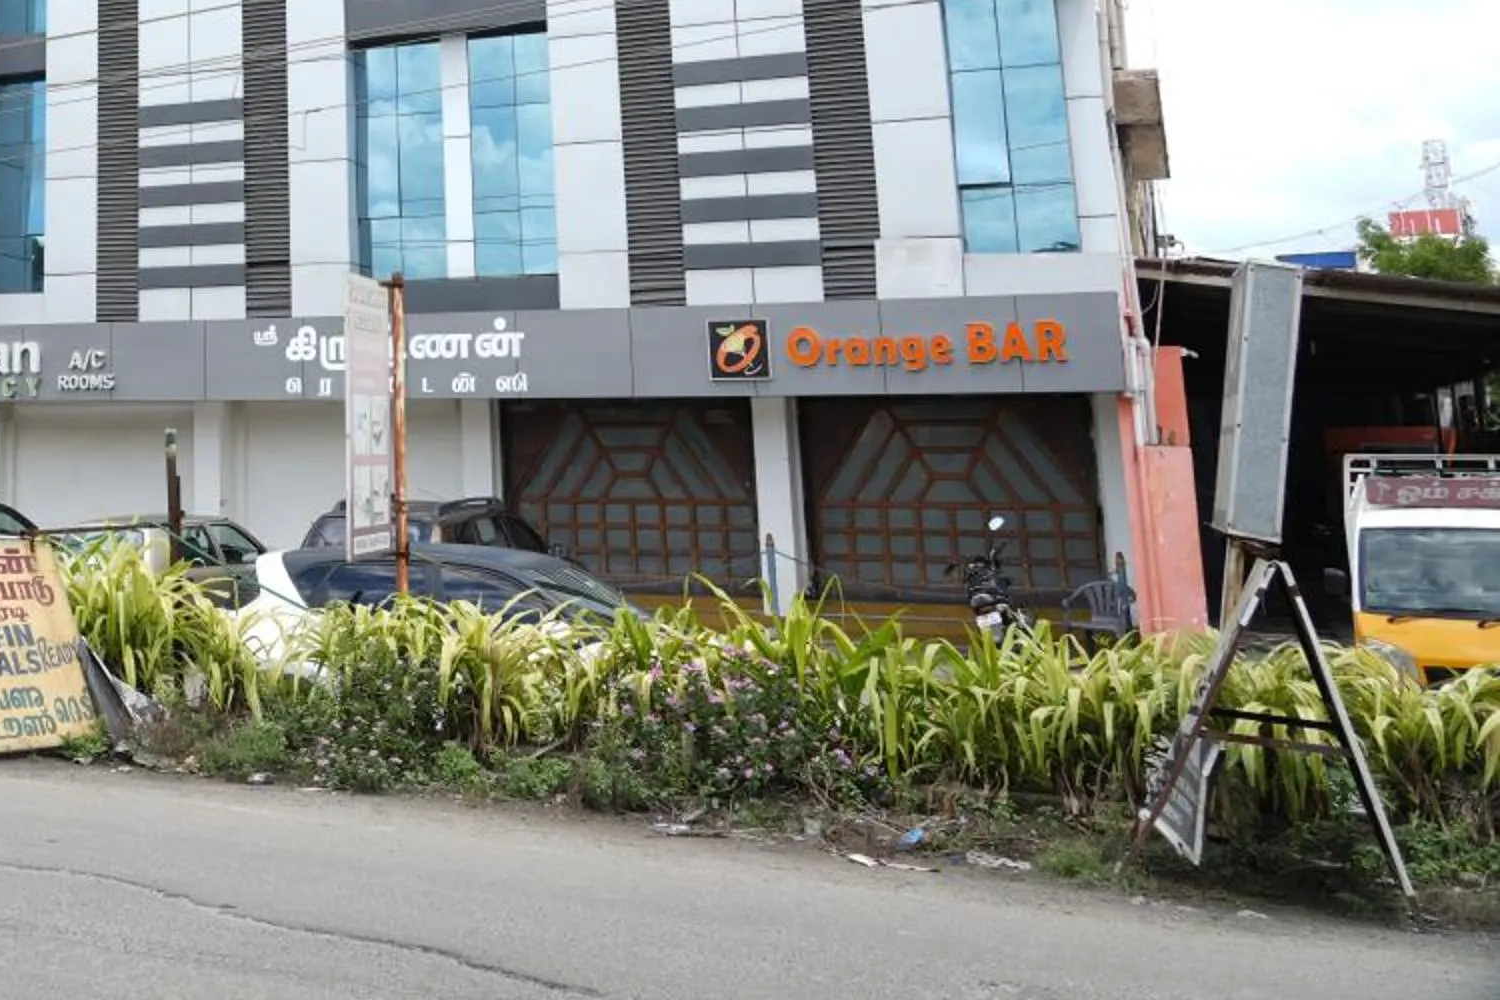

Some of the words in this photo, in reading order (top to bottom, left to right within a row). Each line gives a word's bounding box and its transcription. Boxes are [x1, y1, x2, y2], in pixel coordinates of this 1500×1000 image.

[785, 325, 955, 371] Orange
[965, 318, 1070, 365] BAR
[68, 347, 106, 371] A/C
[57, 374, 116, 392] ROOMS
